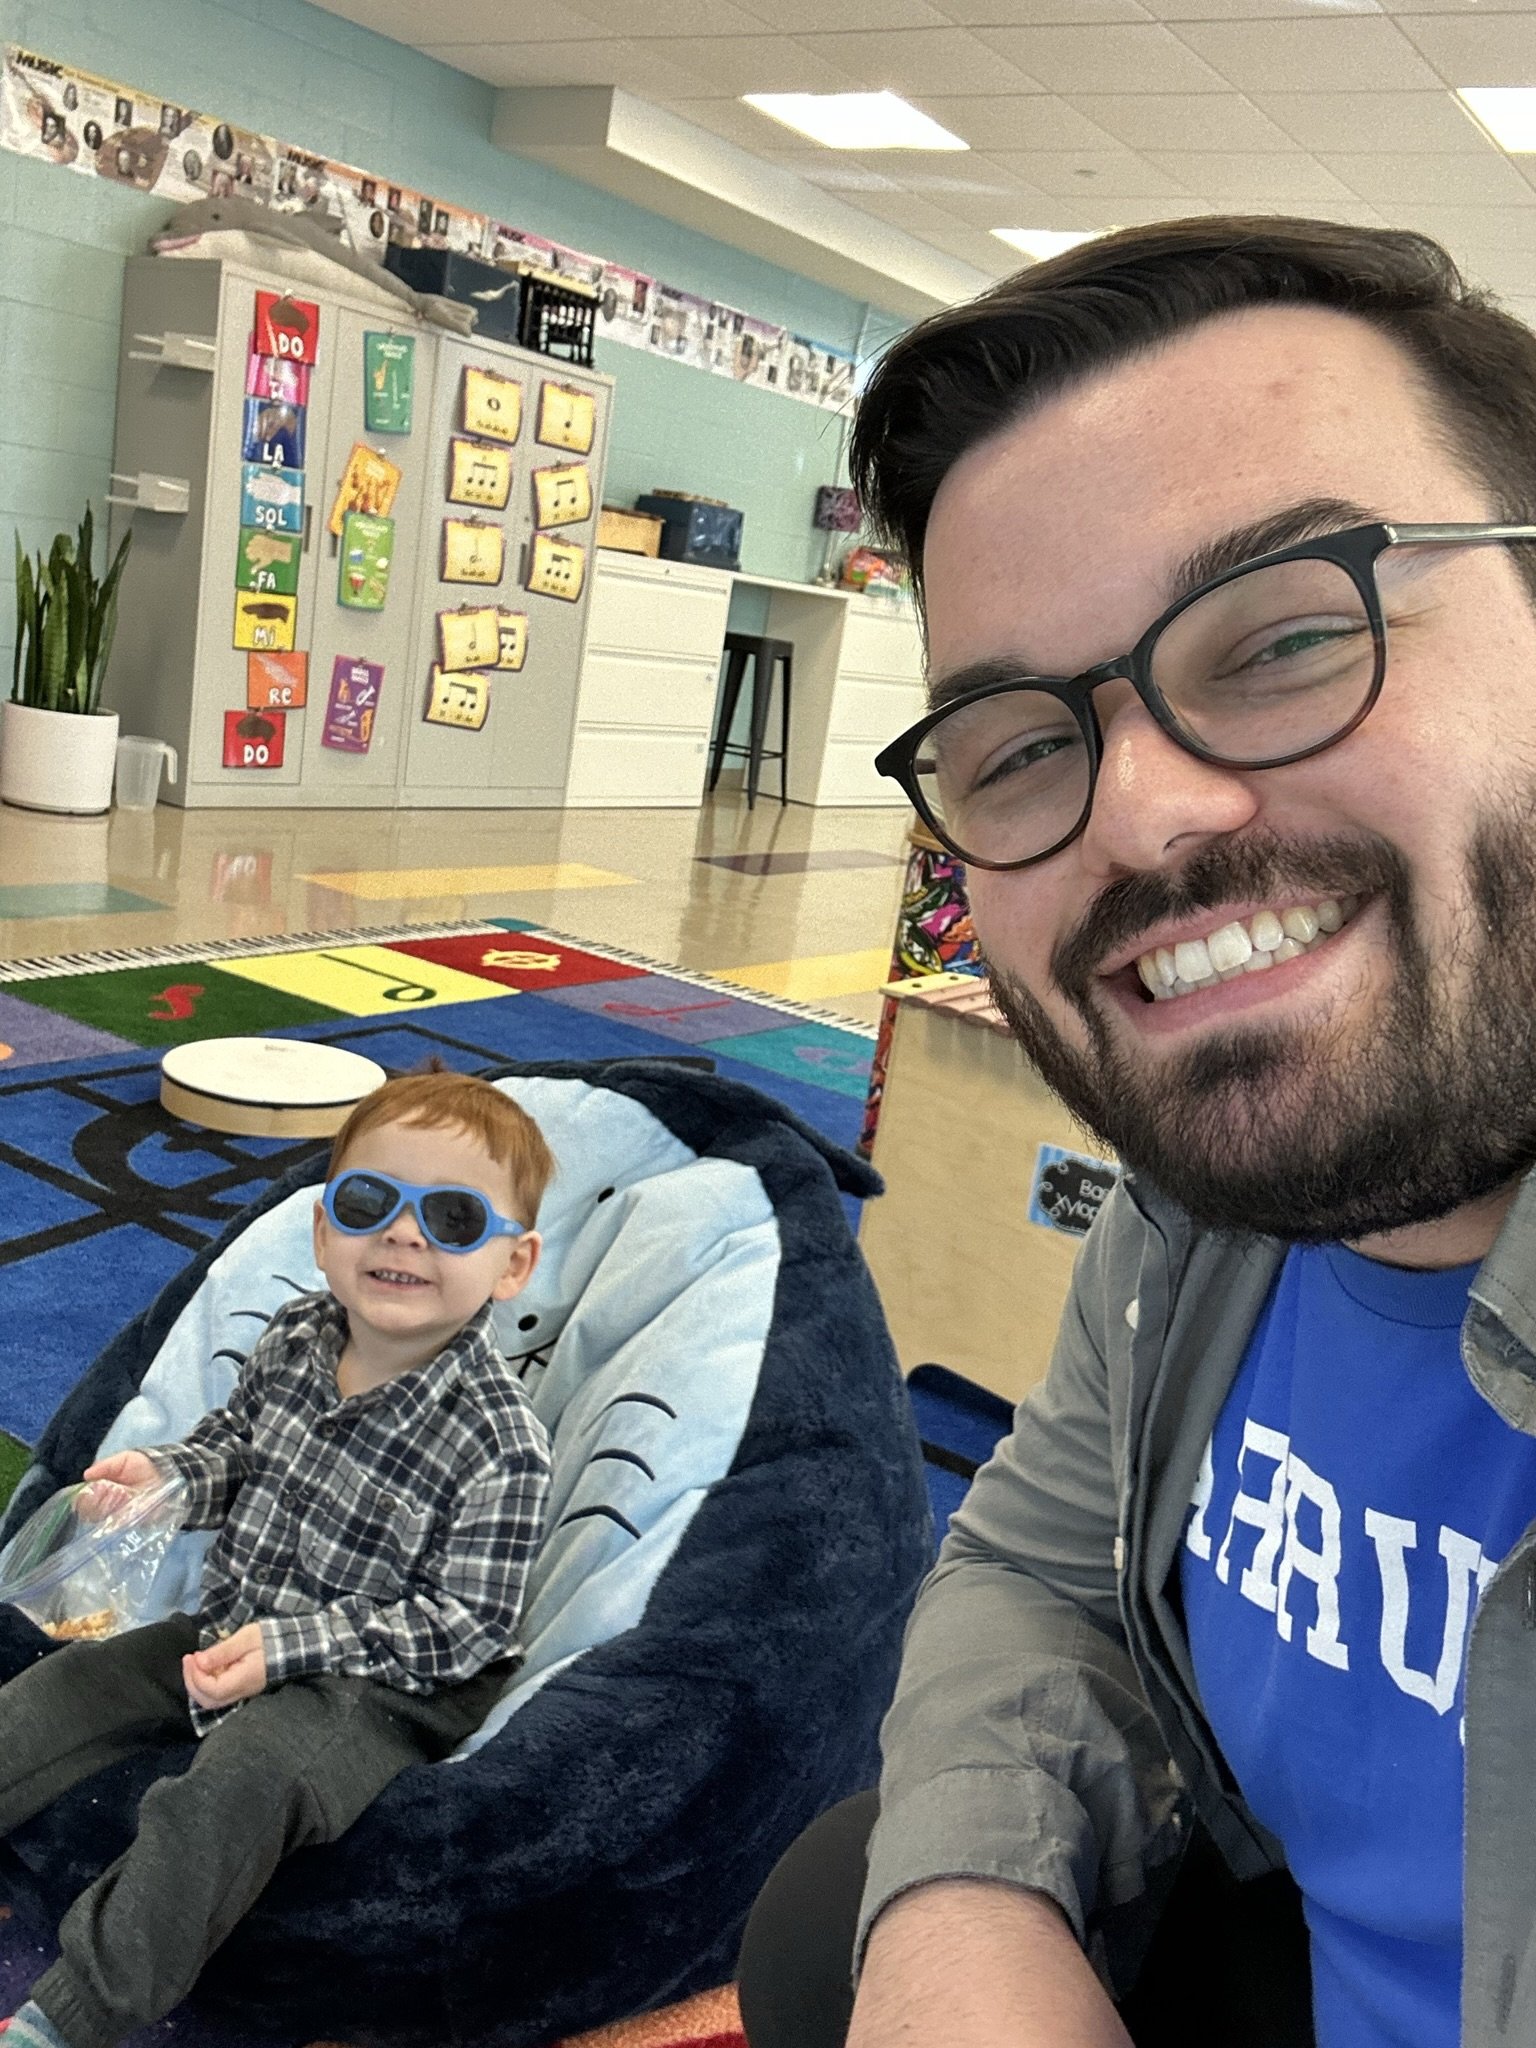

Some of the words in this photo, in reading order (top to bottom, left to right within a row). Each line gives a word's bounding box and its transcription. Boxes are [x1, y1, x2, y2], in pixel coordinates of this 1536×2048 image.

[277, 333, 304, 357] DO
[262, 443, 285, 462] LA
[256, 505, 287, 526] SOL
[258, 571, 276, 589] FA
[243, 744, 269, 765] DO
